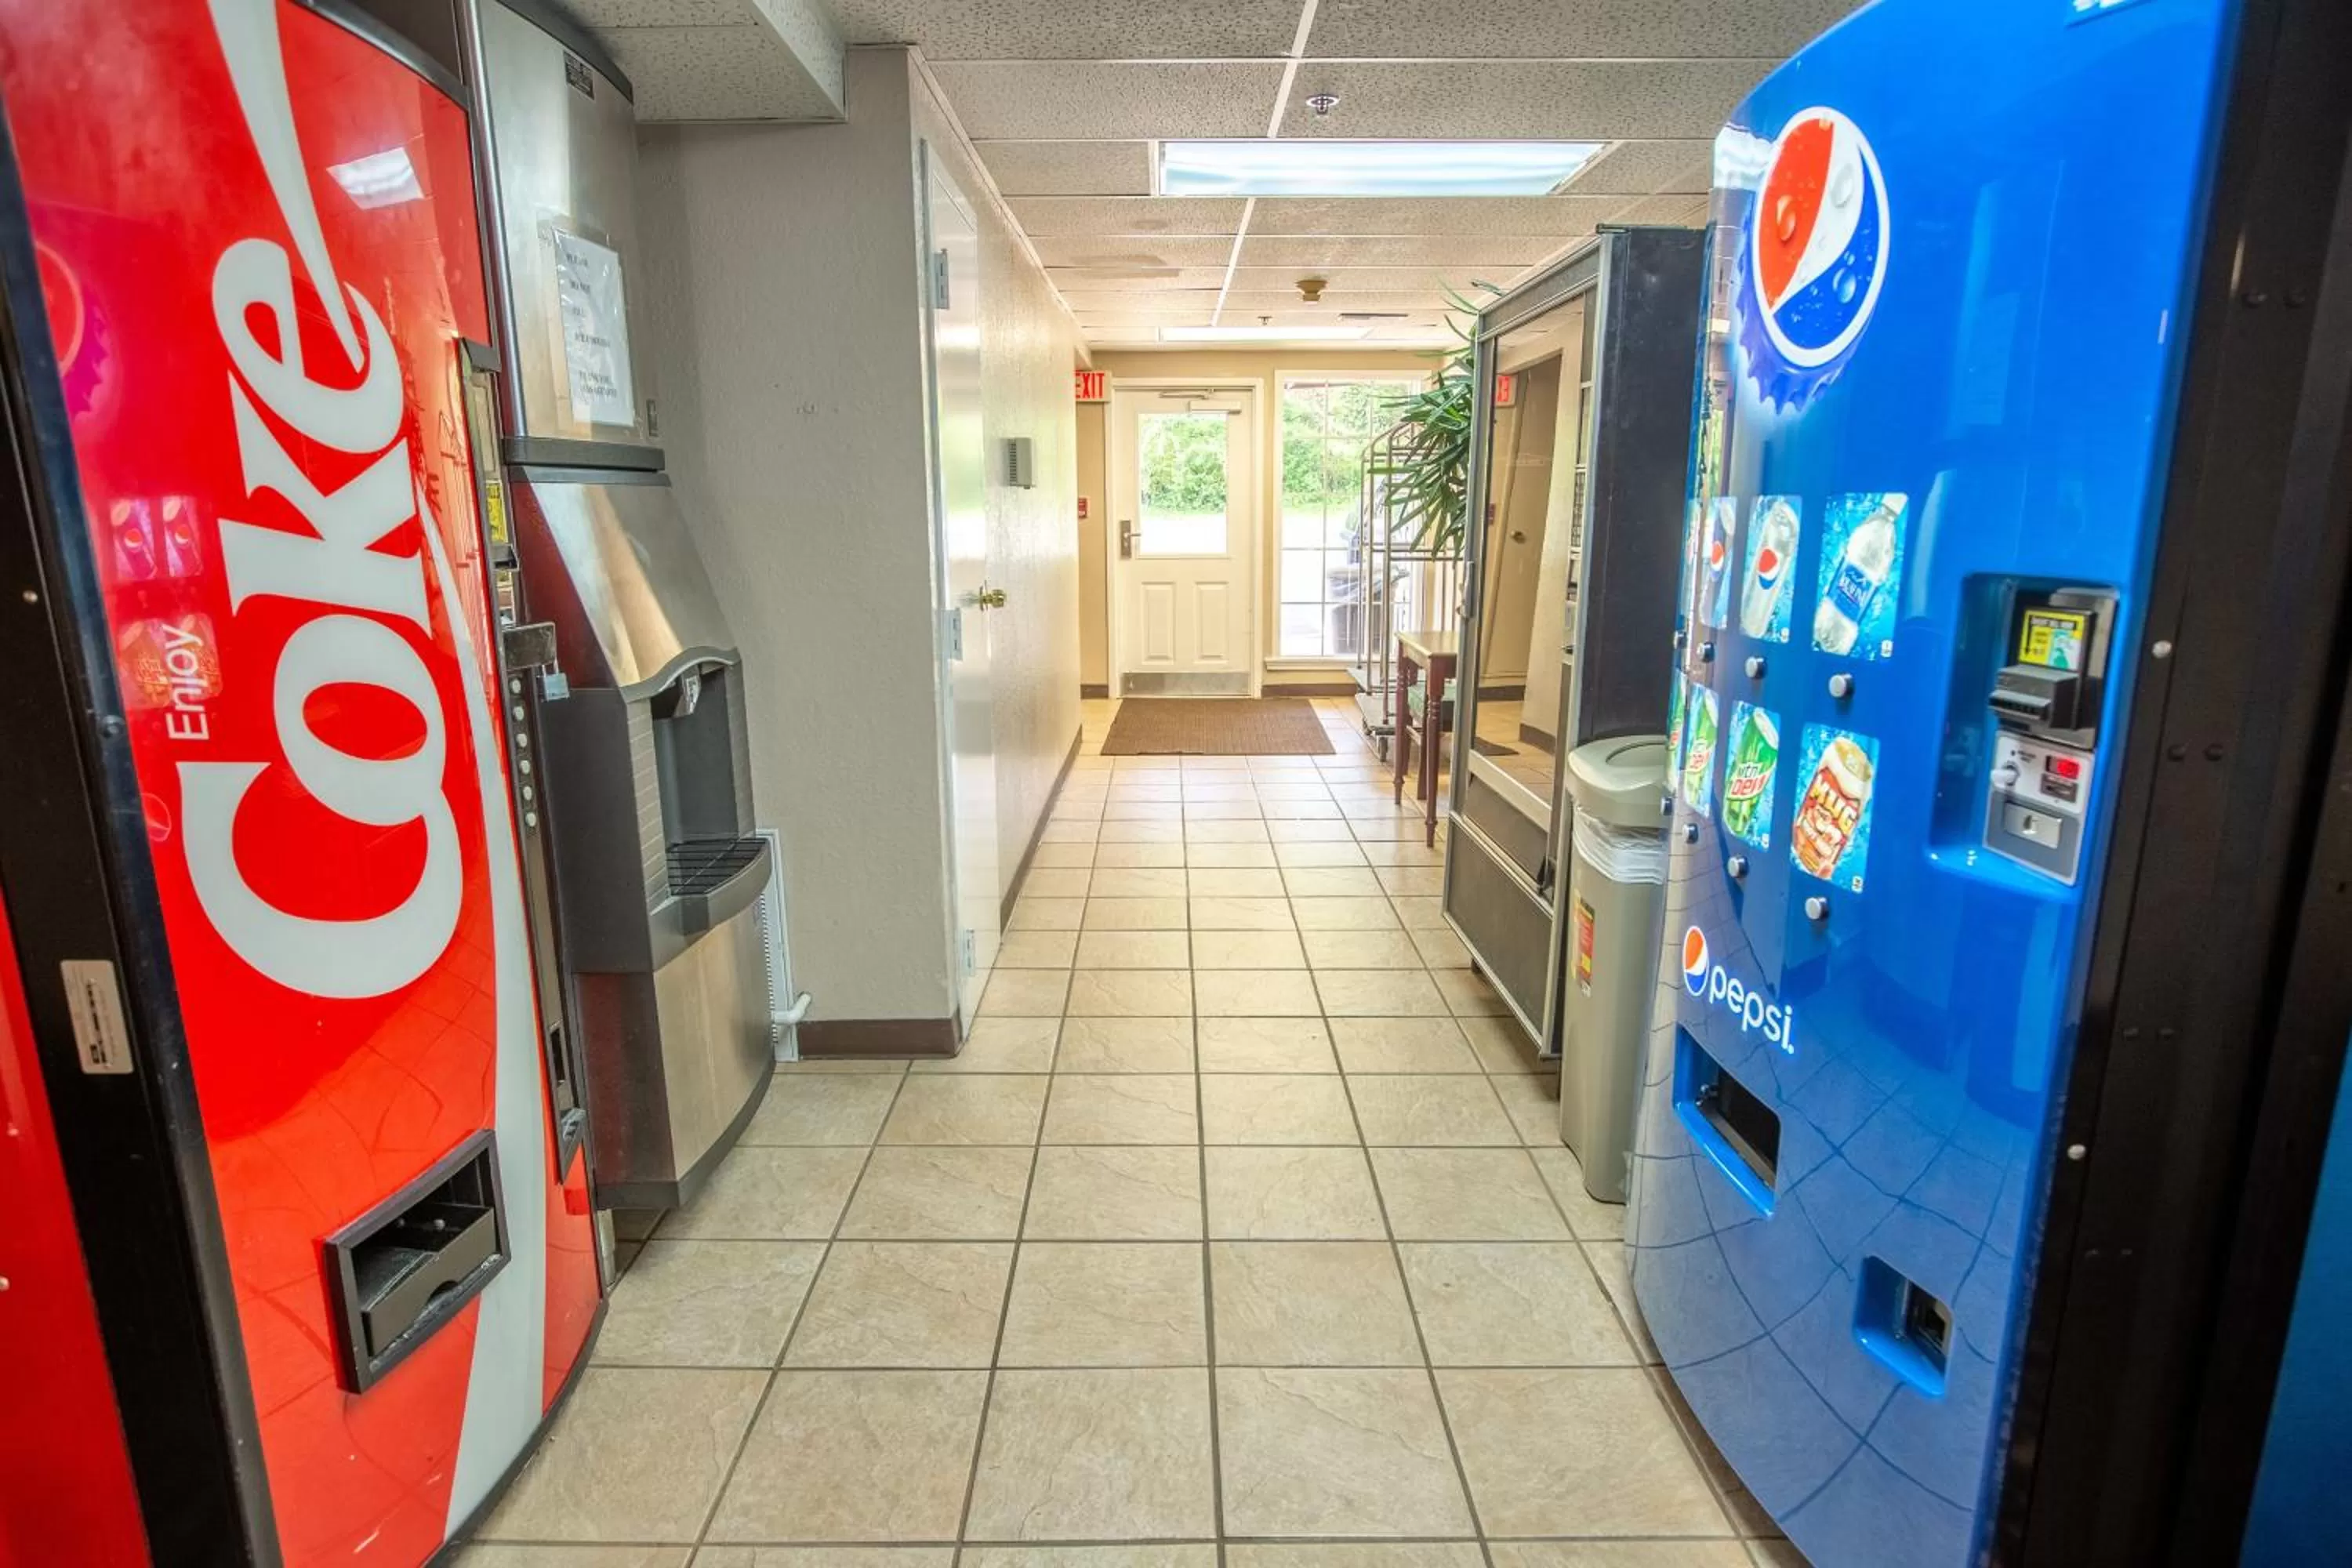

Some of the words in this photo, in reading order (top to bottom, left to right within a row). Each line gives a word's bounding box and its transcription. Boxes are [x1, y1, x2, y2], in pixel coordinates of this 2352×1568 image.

[1075, 372, 1105, 399] EXIT
[176, 238, 463, 999] Coke
[161, 622, 210, 741] Enjoy
[1807, 771, 1858, 837] MUG
[1708, 964, 1792, 1053] pepsi
